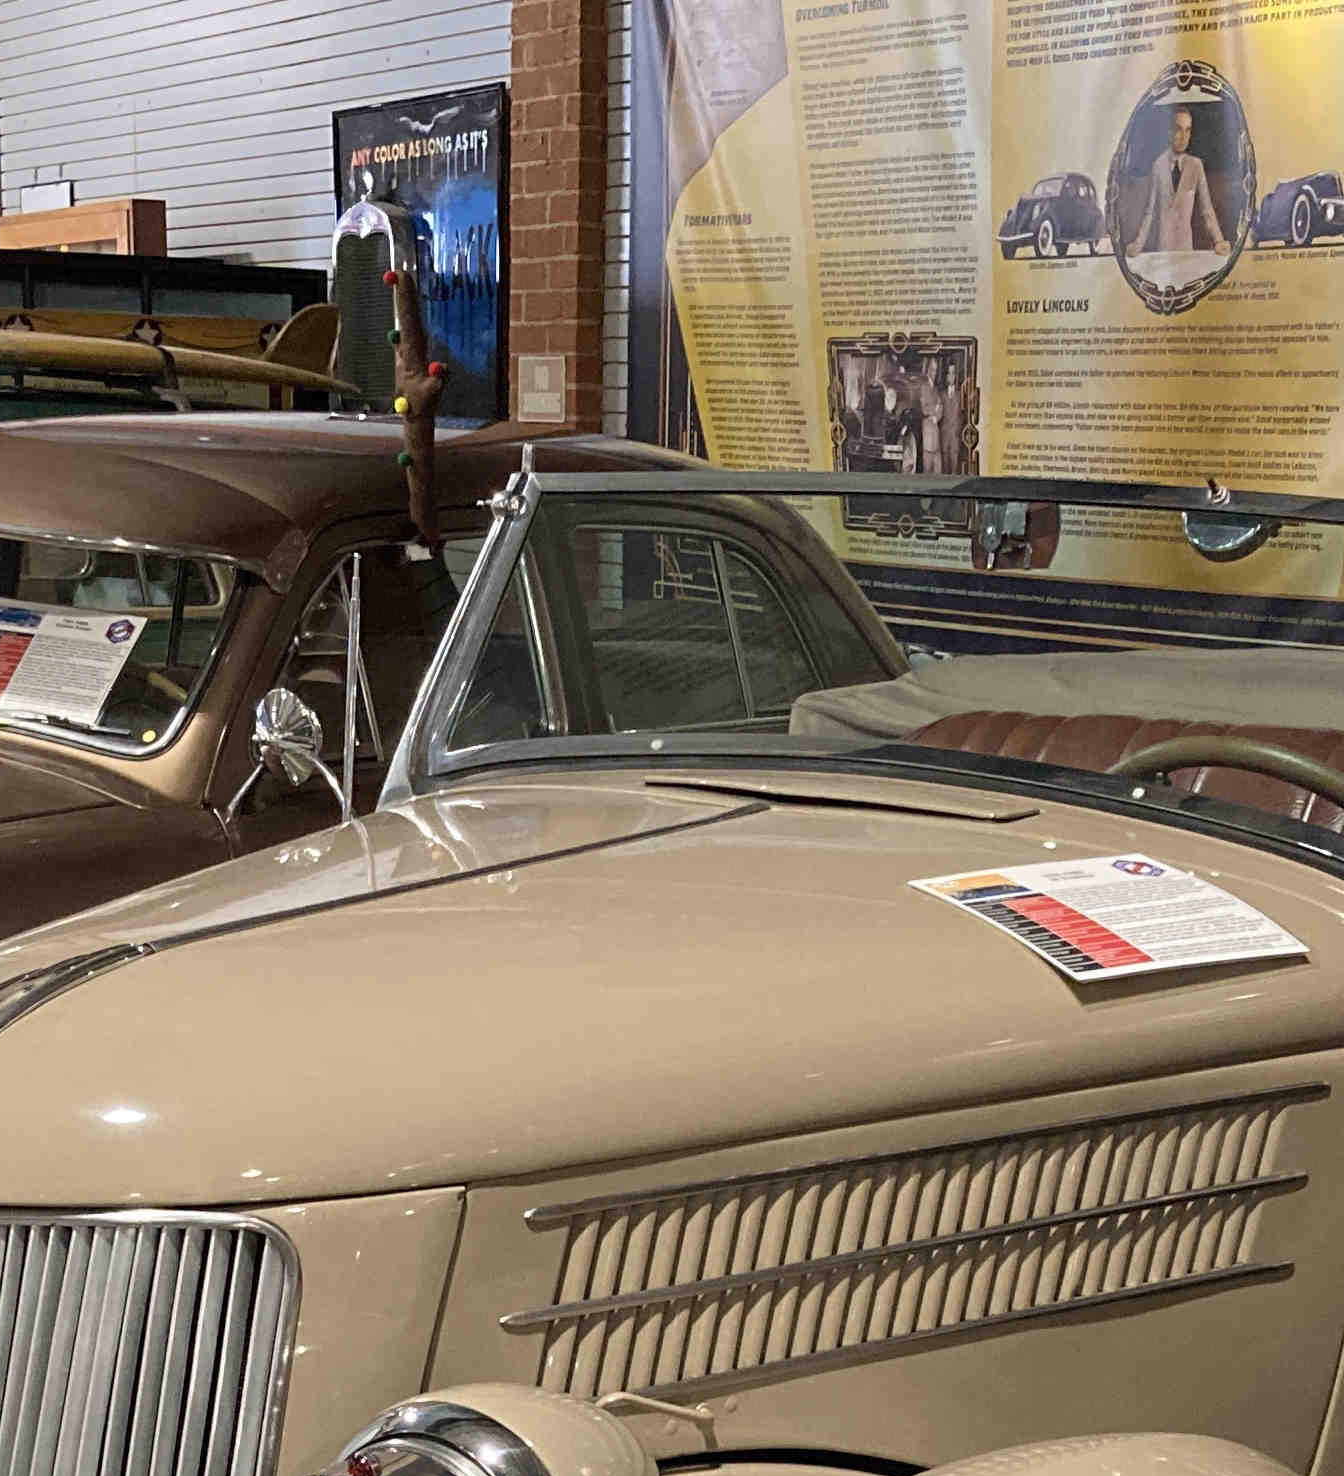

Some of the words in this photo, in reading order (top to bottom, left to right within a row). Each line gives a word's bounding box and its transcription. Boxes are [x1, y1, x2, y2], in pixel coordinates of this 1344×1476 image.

[1269, 10, 1290, 23] PART
[374, 144, 405, 163] COLOR
[408, 140, 421, 158] AS
[422, 136, 452, 155] LONG
[455, 132, 468, 150] AS
[1006, 300, 1040, 314] LOVELY
[1042, 298, 1089, 314] LINCOLNS
